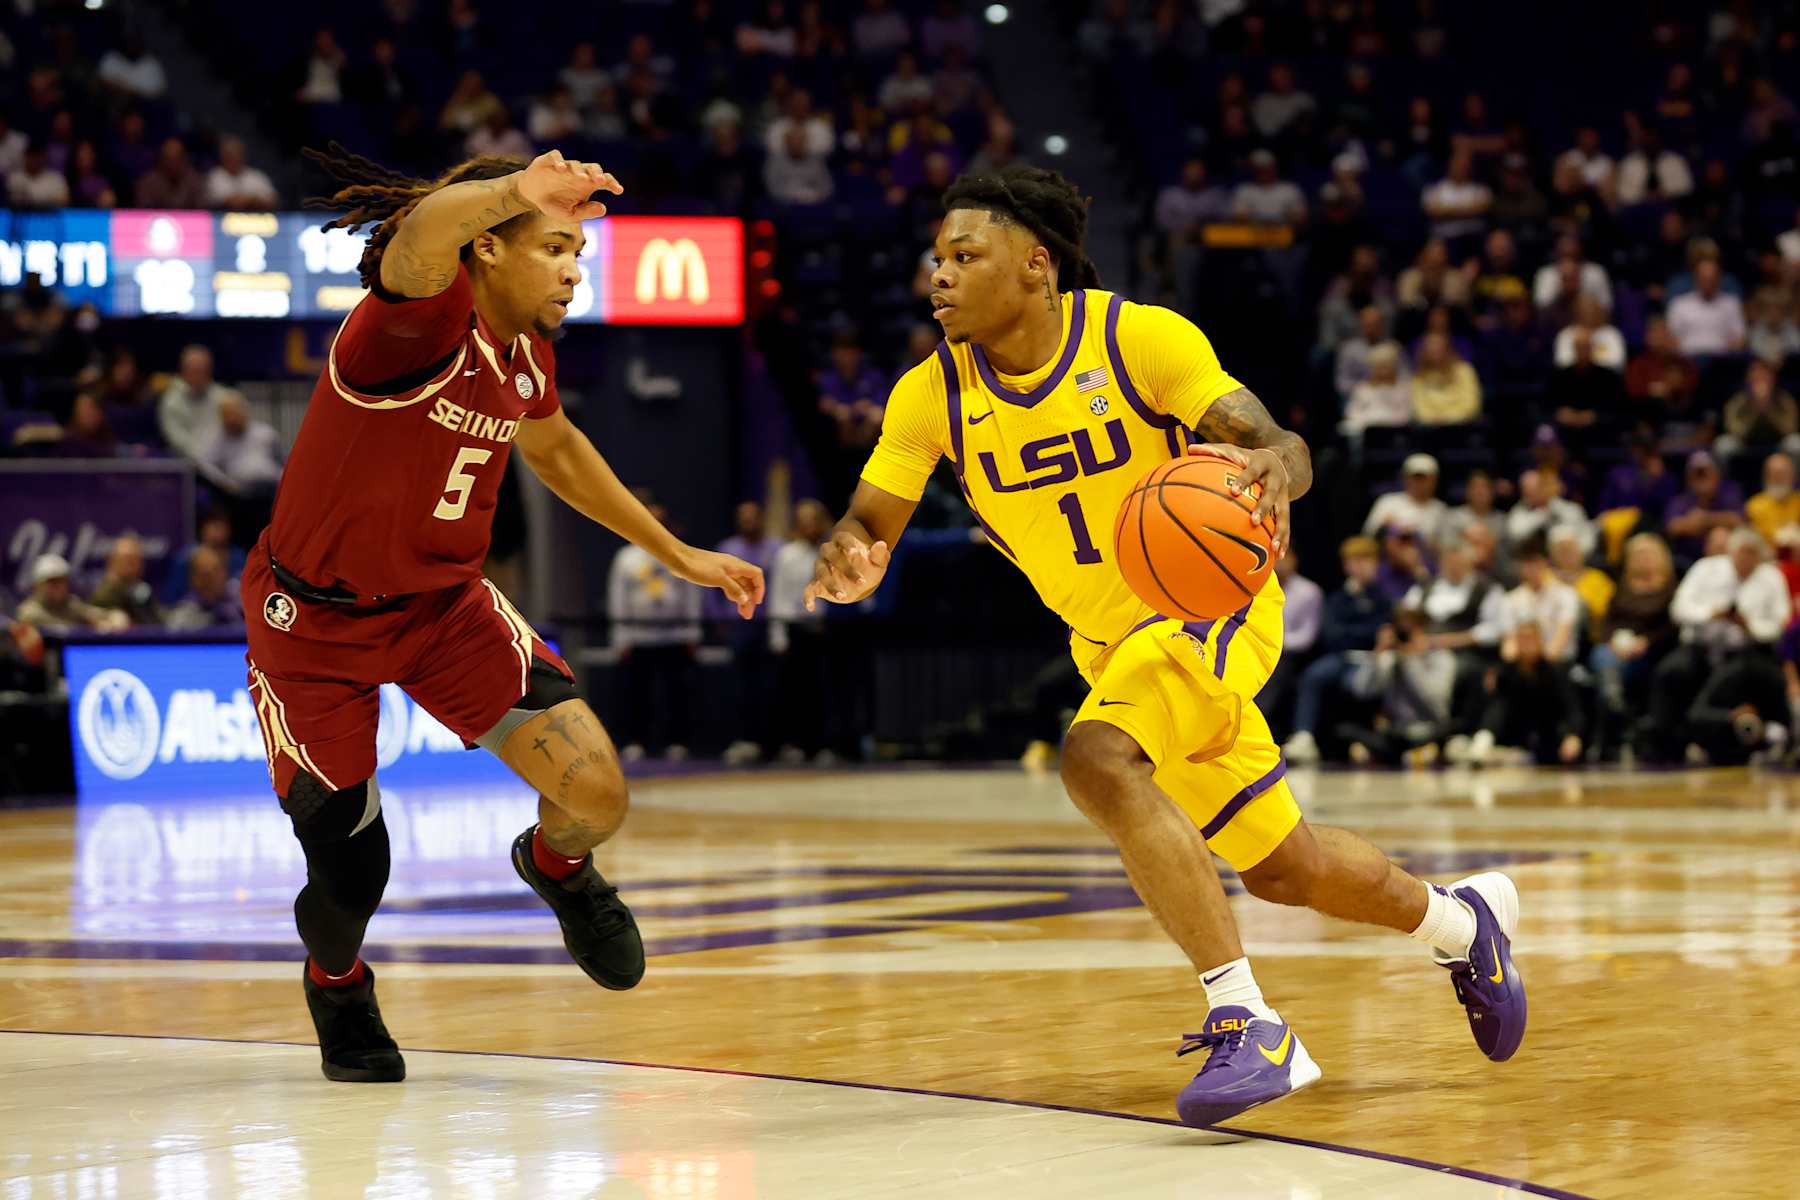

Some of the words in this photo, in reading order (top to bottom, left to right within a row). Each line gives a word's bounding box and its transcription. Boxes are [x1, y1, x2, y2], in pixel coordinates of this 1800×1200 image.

[433, 447, 494, 521] 5
[977, 418, 1132, 493] LSU
[1058, 492, 1104, 565] 1
[159, 688, 268, 764] Allst
[1211, 1018, 1248, 1034] LSU
